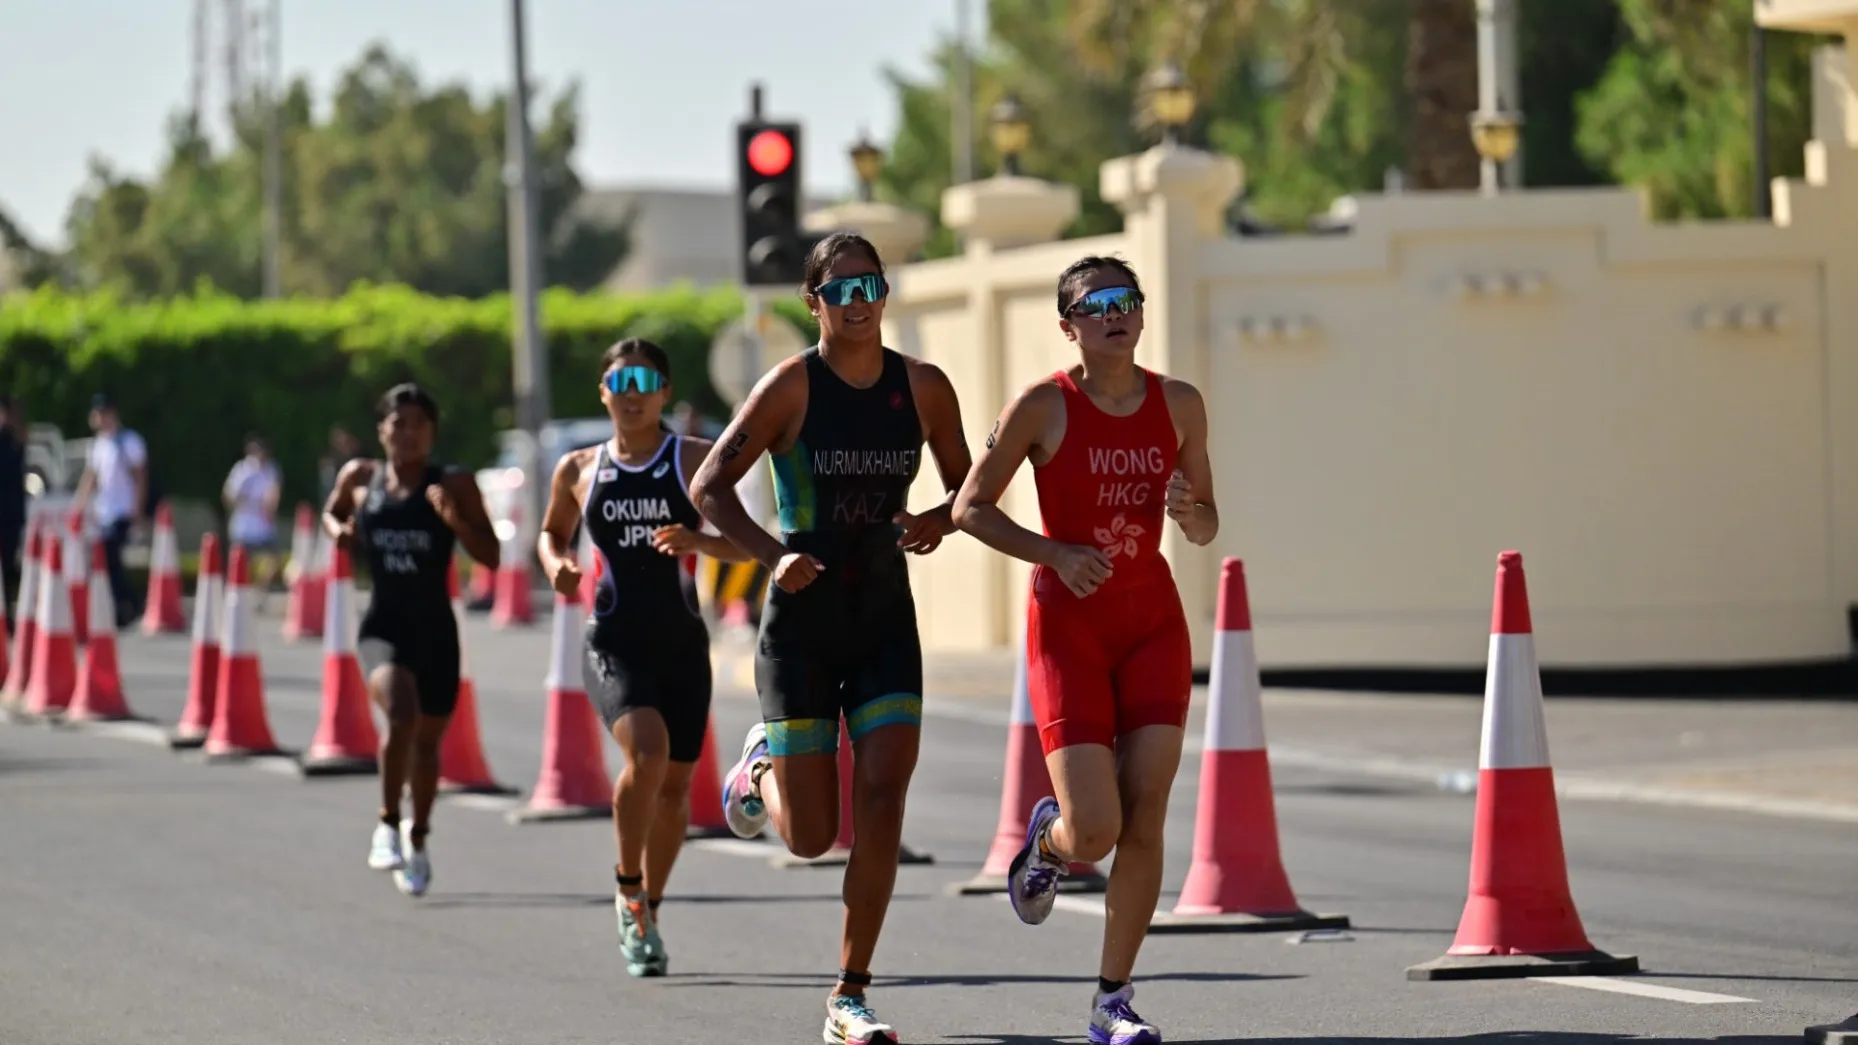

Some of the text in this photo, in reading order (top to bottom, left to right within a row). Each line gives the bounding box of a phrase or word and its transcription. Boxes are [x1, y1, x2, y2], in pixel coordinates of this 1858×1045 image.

[813, 449, 916, 476] NURMUKHAMET
[1088, 446, 1165, 475] WONG
[832, 491, 887, 524] KAZ
[1097, 482, 1151, 507] HKG
[602, 498, 672, 521] OKUMA
